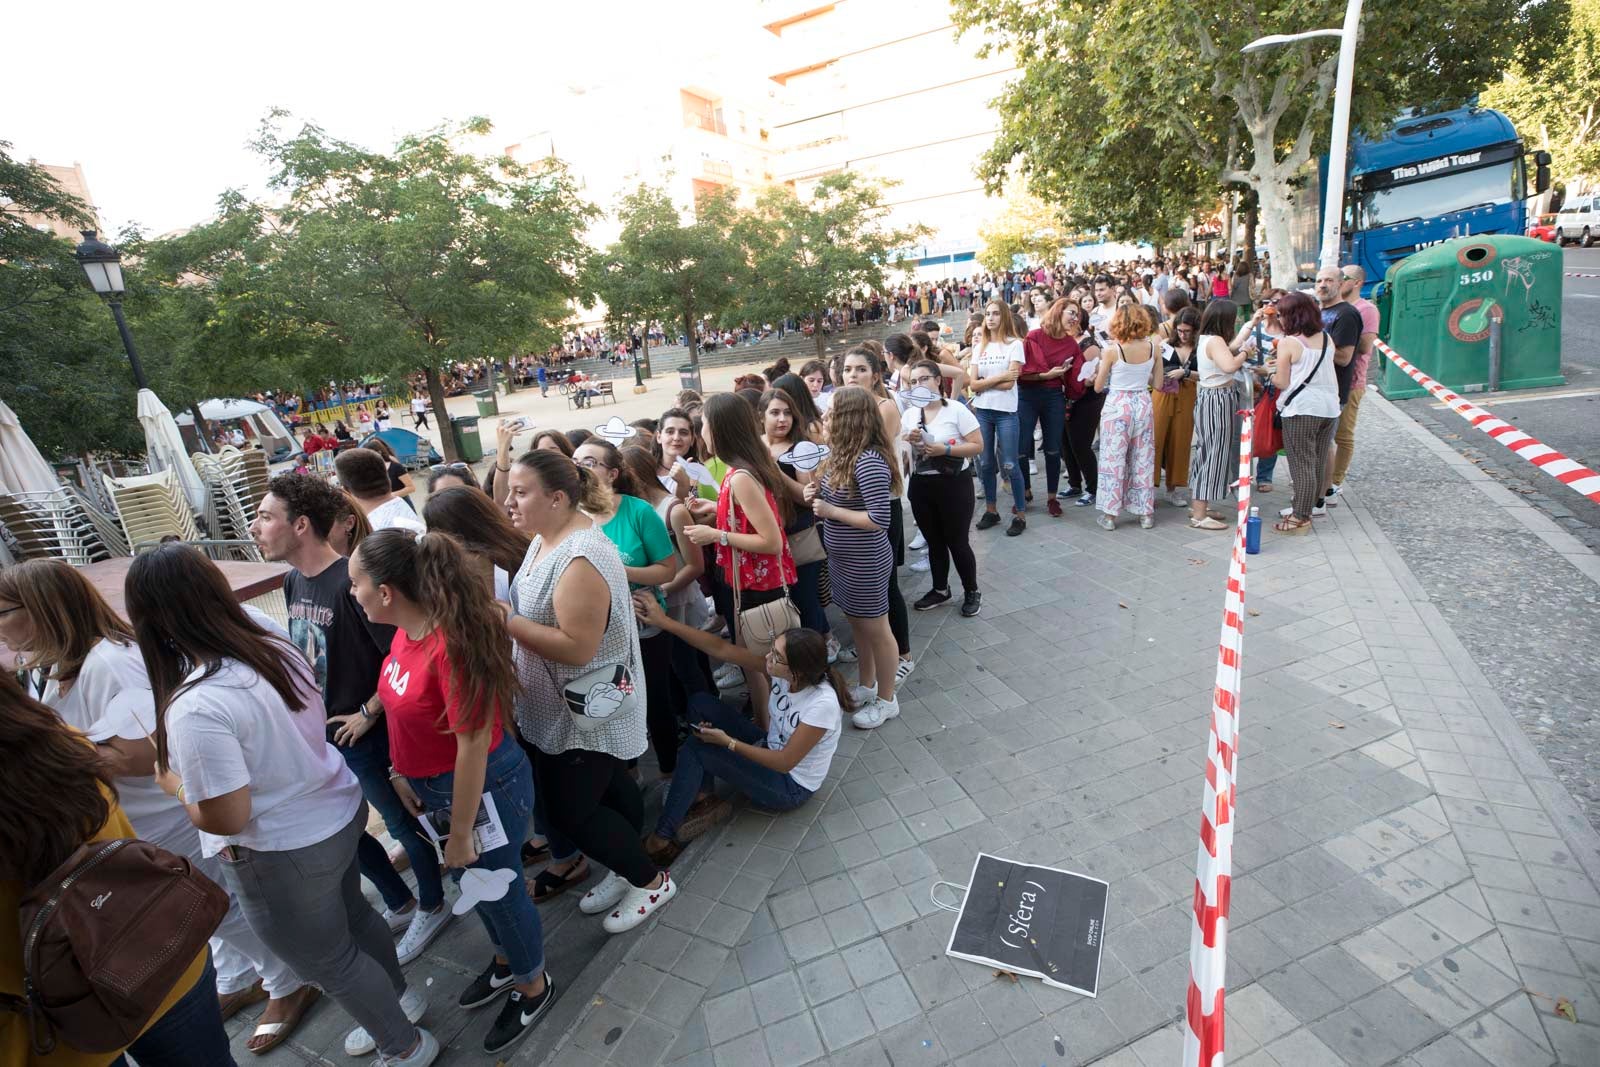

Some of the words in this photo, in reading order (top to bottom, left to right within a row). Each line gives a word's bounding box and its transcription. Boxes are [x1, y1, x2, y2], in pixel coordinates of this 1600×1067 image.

[1391, 166, 1418, 180] The
[1417, 157, 1449, 174] Wild
[1449, 152, 1482, 166] Tour
[1459, 270, 1494, 285] 530
[383, 656, 410, 696] FILA
